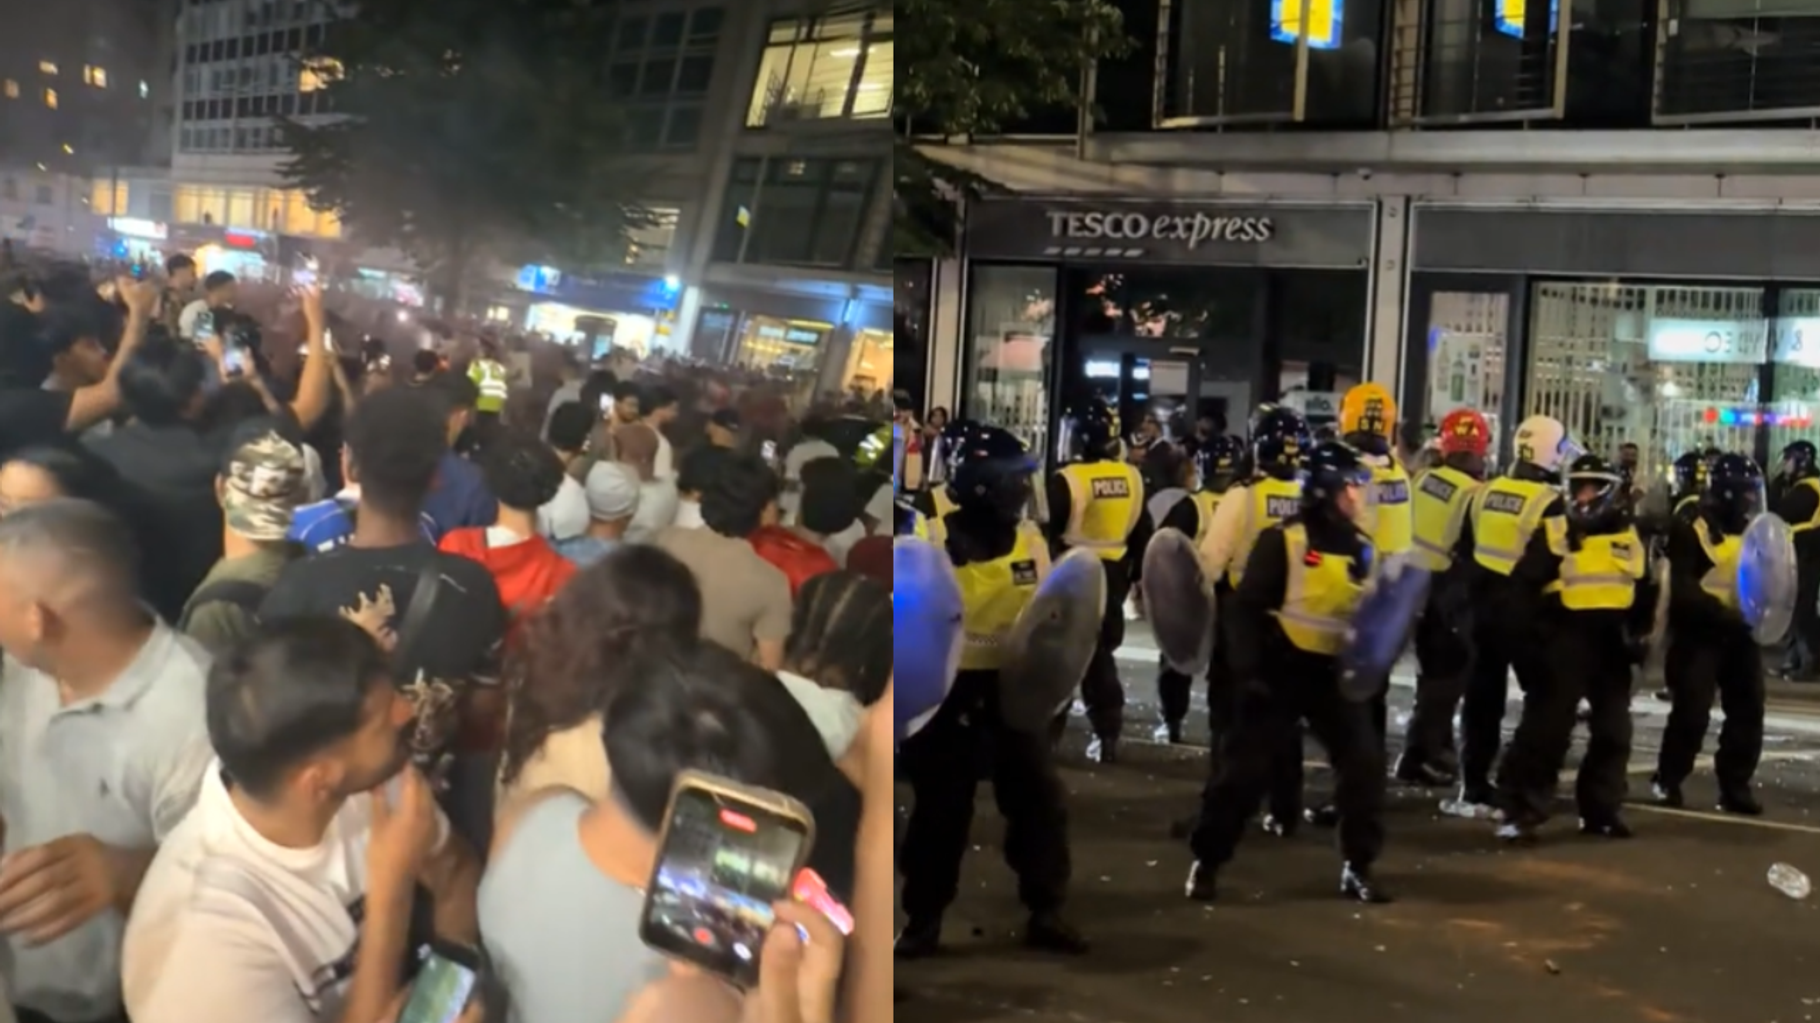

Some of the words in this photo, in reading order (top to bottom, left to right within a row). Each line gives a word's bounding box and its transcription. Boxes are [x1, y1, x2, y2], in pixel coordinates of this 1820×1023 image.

[1046, 212, 1149, 239] TESCO
[1152, 212, 1273, 249] express
[1092, 479, 1128, 496] POLICE
[1268, 498, 1300, 515] POLI
